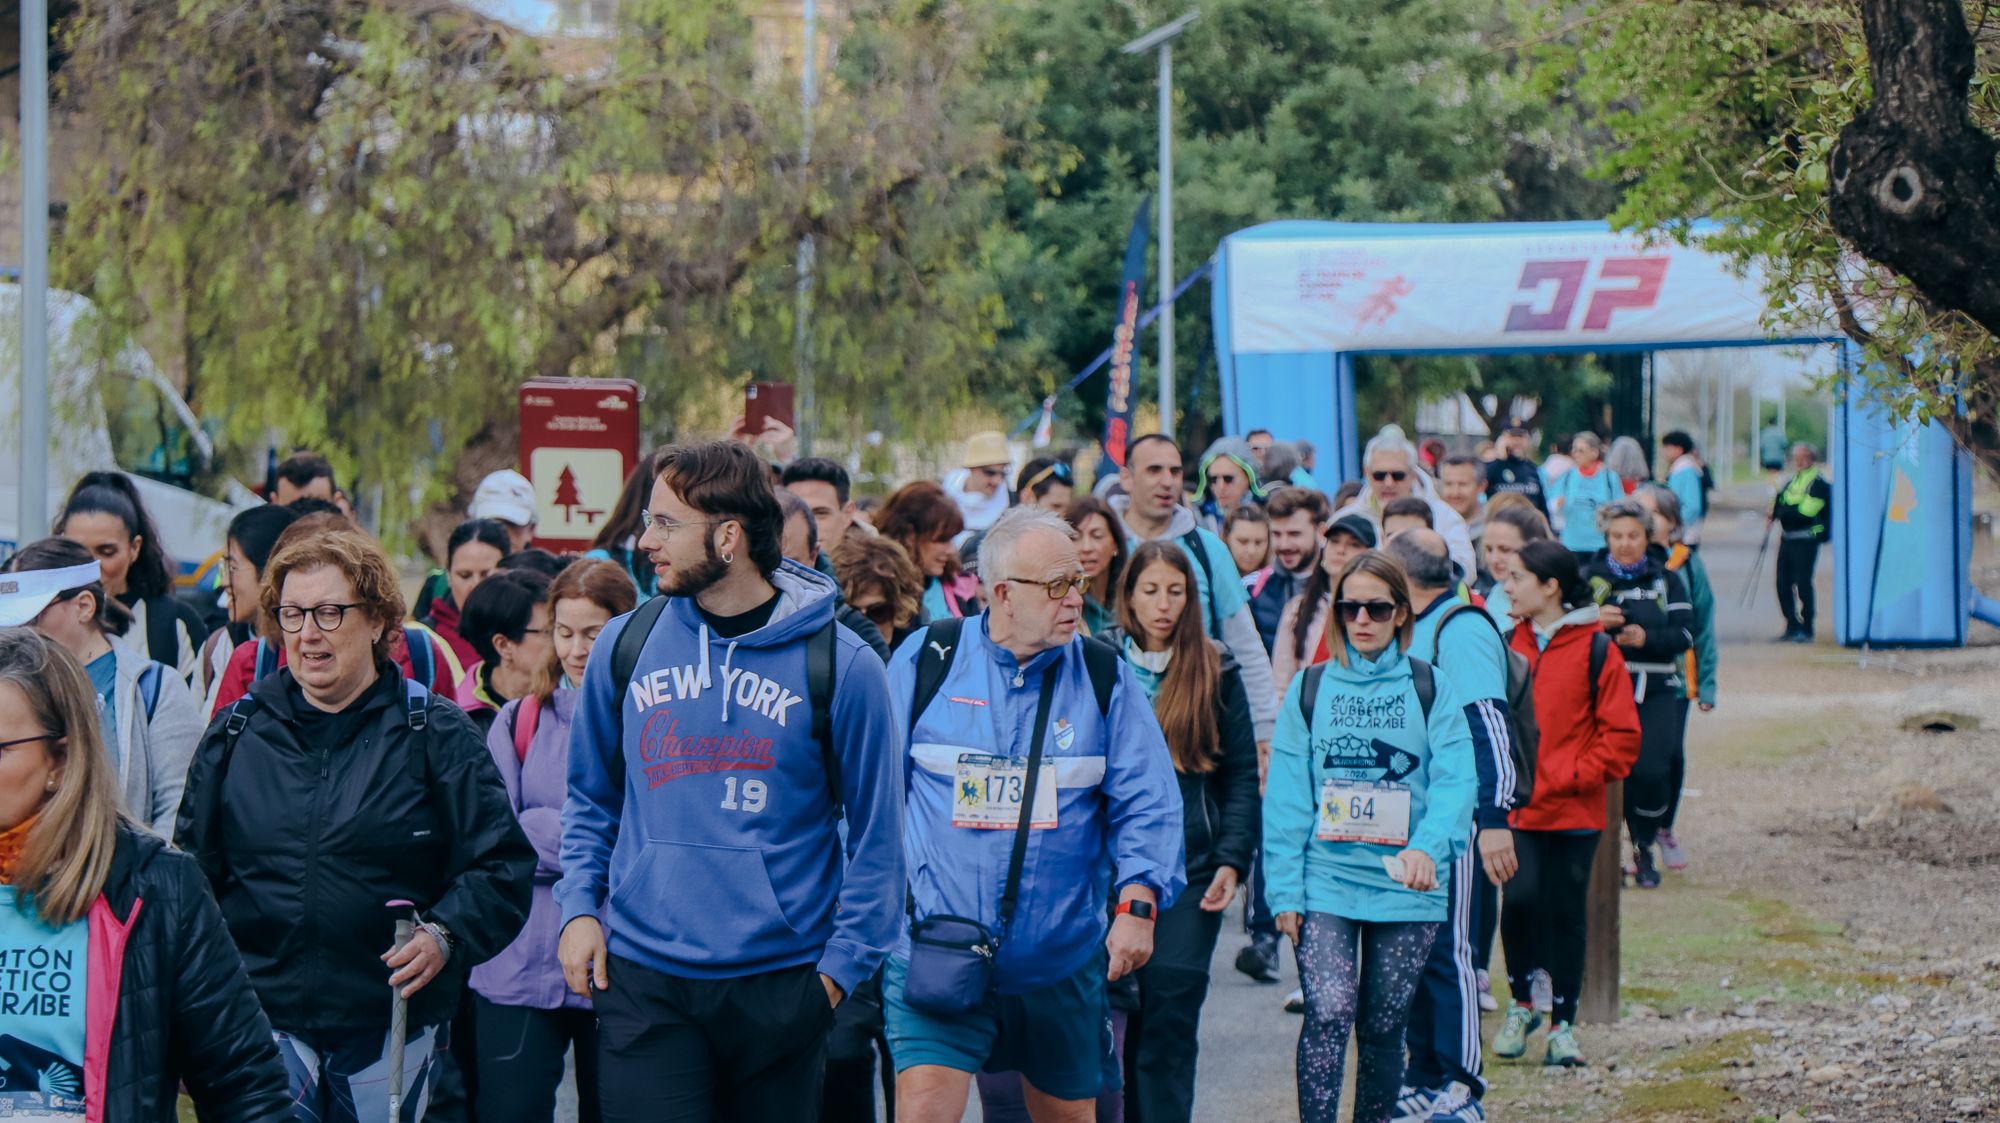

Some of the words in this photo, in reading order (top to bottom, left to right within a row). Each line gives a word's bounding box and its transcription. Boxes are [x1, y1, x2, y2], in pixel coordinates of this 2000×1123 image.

[629, 663, 704, 713] NEW
[719, 665, 804, 728] YORK
[1329, 716, 1406, 729] MOZARABE
[639, 708, 775, 771] Champion
[720, 776, 768, 813] 19
[984, 775, 1023, 803] 173
[1349, 796, 1375, 821] 64
[0, 968, 71, 993] TICO
